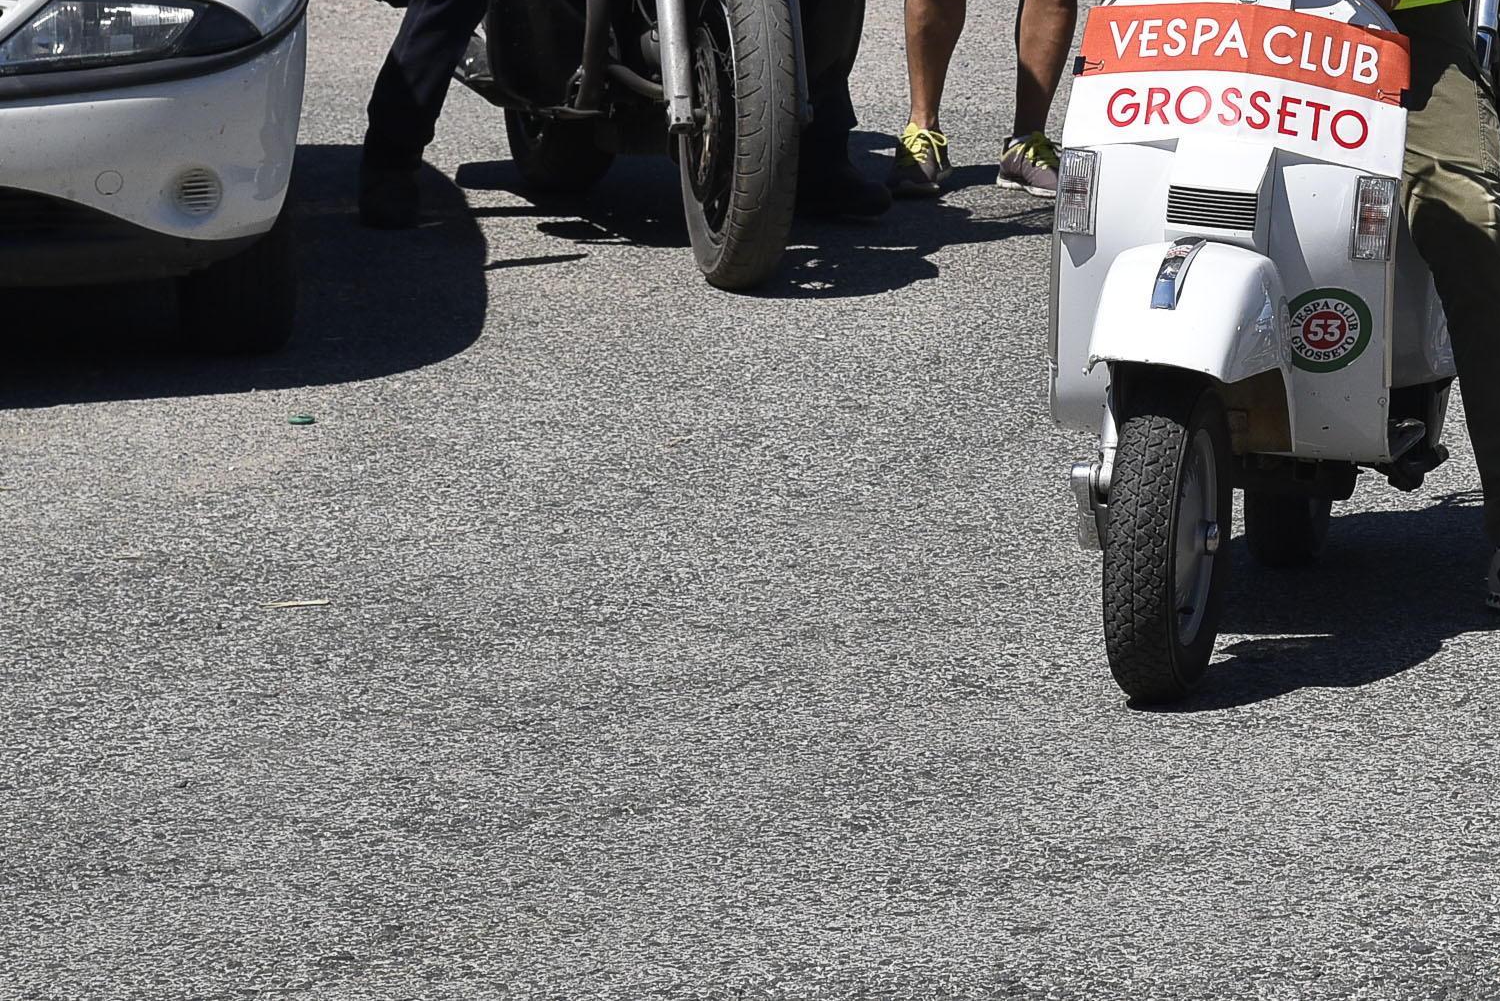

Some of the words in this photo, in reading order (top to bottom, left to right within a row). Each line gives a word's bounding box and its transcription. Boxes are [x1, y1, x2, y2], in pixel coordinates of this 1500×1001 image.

[1109, 17, 1249, 59] VESPA
[1263, 24, 1380, 85] CLUB
[1107, 85, 1369, 149] GROSSETO
[1290, 300, 1332, 329] VESPA
[1333, 302, 1359, 332] CLUB
[1308, 319, 1342, 342] 53
[1291, 335, 1356, 360] GROSSETO
